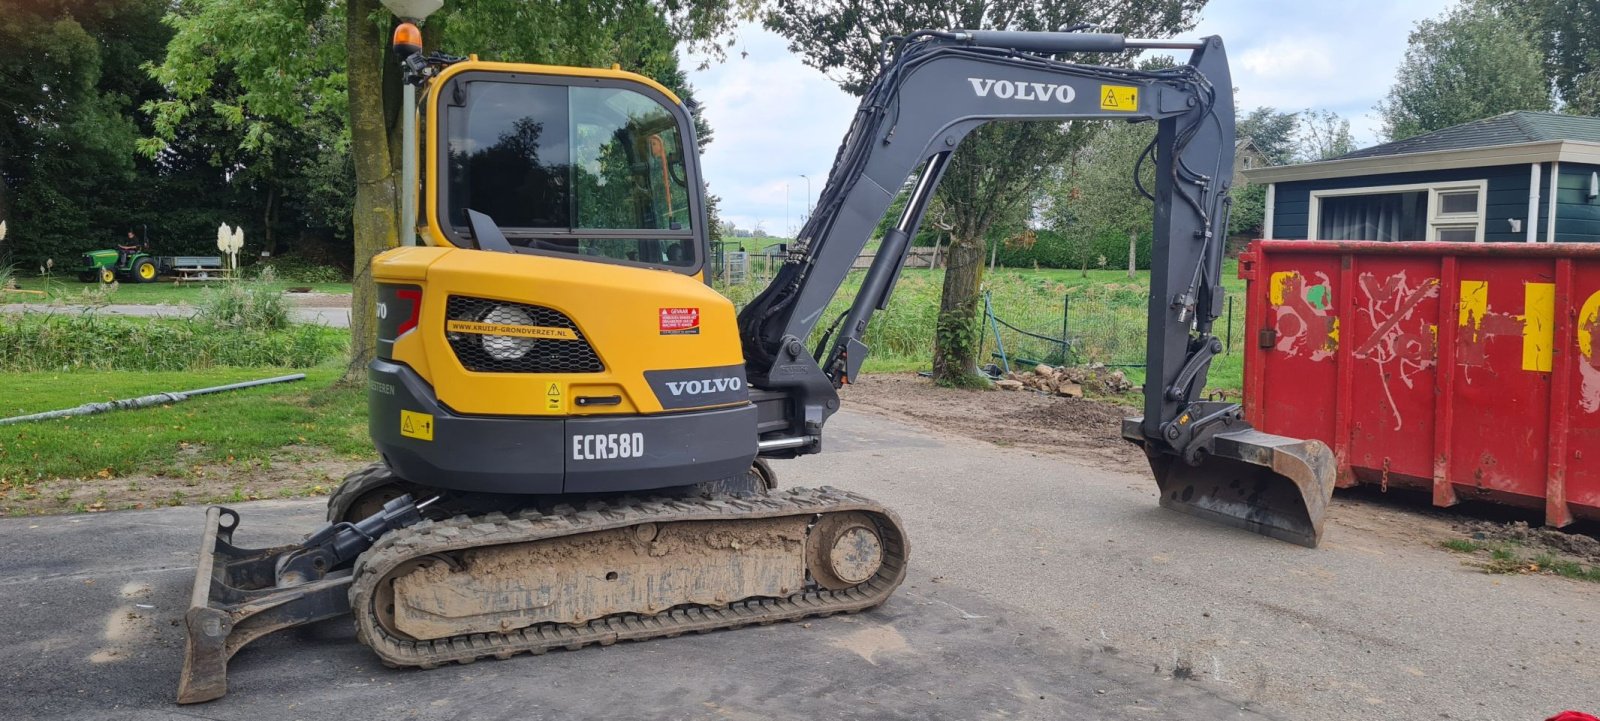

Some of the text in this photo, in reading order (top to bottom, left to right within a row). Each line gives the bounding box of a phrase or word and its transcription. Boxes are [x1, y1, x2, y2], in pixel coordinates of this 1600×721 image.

[968, 77, 1076, 104] VOLVO
[452, 322, 568, 338] WWW.KRUIJF-GRONDVERZET.NL
[665, 377, 742, 396] VOLVO
[572, 432, 644, 460] ECR58D
